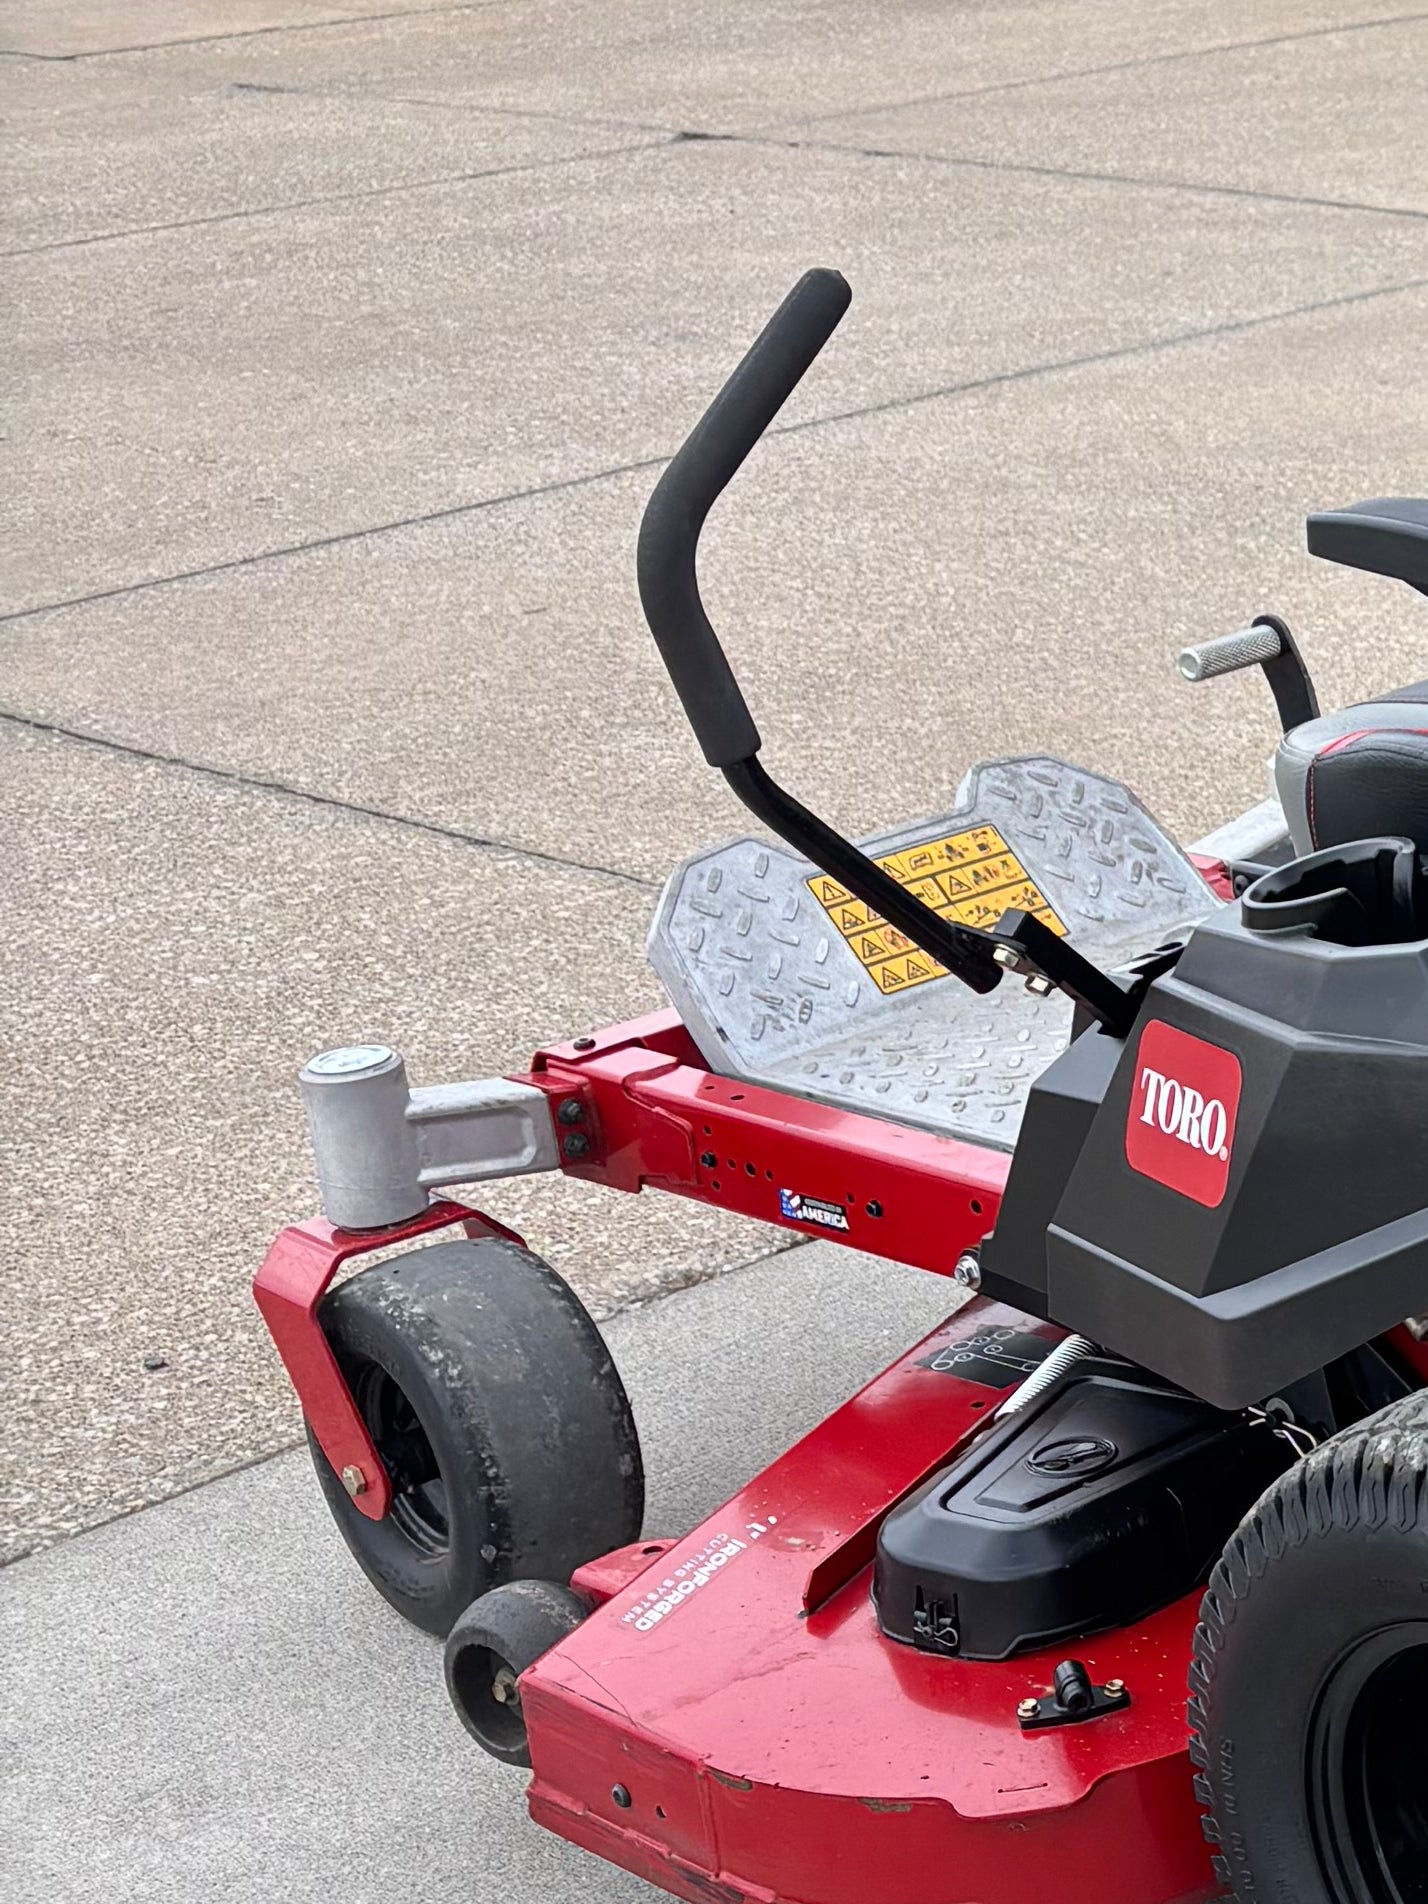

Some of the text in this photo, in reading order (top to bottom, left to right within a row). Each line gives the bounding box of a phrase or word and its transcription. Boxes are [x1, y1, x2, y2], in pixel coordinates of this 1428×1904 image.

[1140, 1067, 1227, 1156] TORO
[802, 1204, 851, 1231] AMERICA
[621, 1532, 728, 1624] CUTTING SYSTEM
[634, 1538, 748, 1632] IRONFORGED
